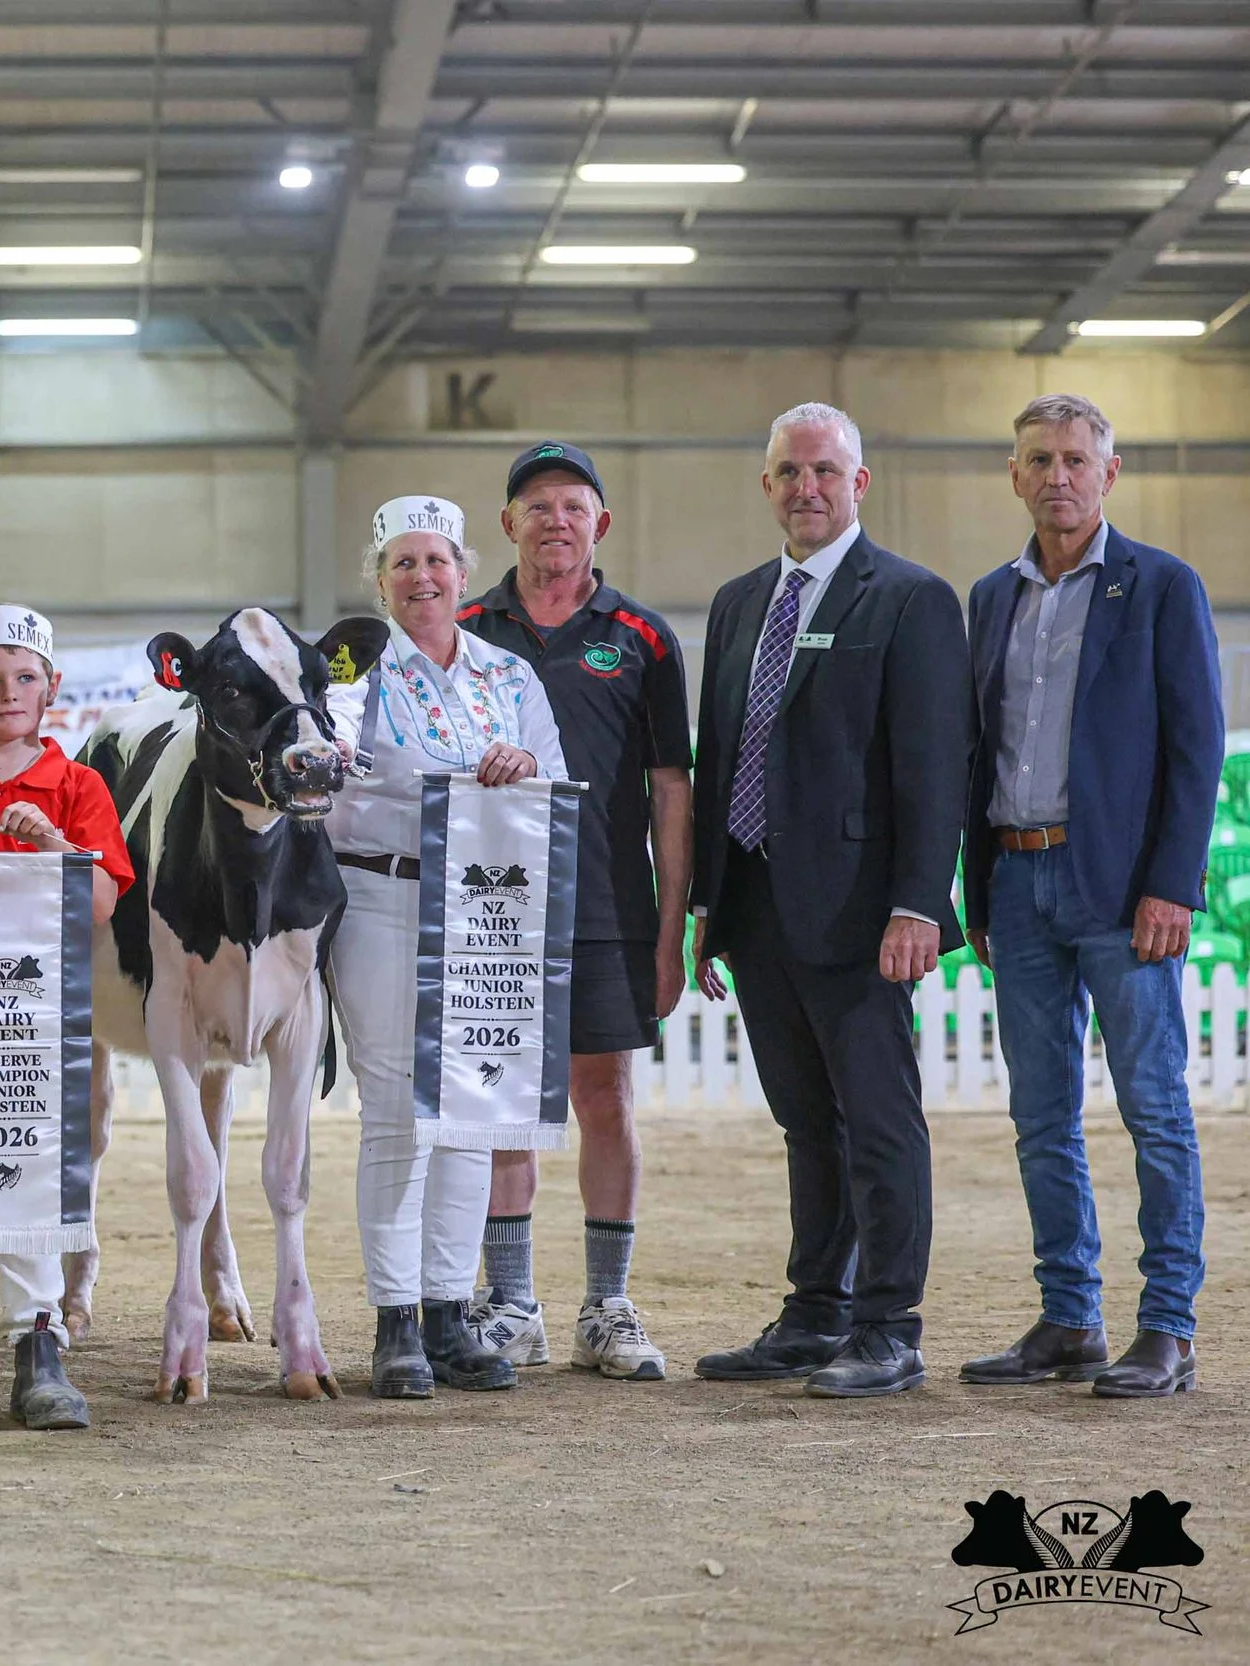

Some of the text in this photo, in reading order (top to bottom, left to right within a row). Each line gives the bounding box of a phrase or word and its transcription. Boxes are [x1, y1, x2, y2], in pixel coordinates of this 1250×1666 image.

[446, 371, 497, 430] K
[373, 513, 454, 544] 3 SEMEX
[7, 622, 50, 654] SEMEX
[489, 869, 501, 878] NZ
[469, 886, 521, 897] DAIRYEVENT
[482, 901, 506, 915] NZ
[467, 917, 522, 931] DAIRY
[466, 933, 523, 947] EVENT
[0, 962, 12, 970] NZ
[448, 961, 539, 977] CHAMPION
[462, 979, 524, 994] JUNIOR
[450, 995, 535, 1010] HOLSTEIN
[462, 1026, 521, 1047] 2026
